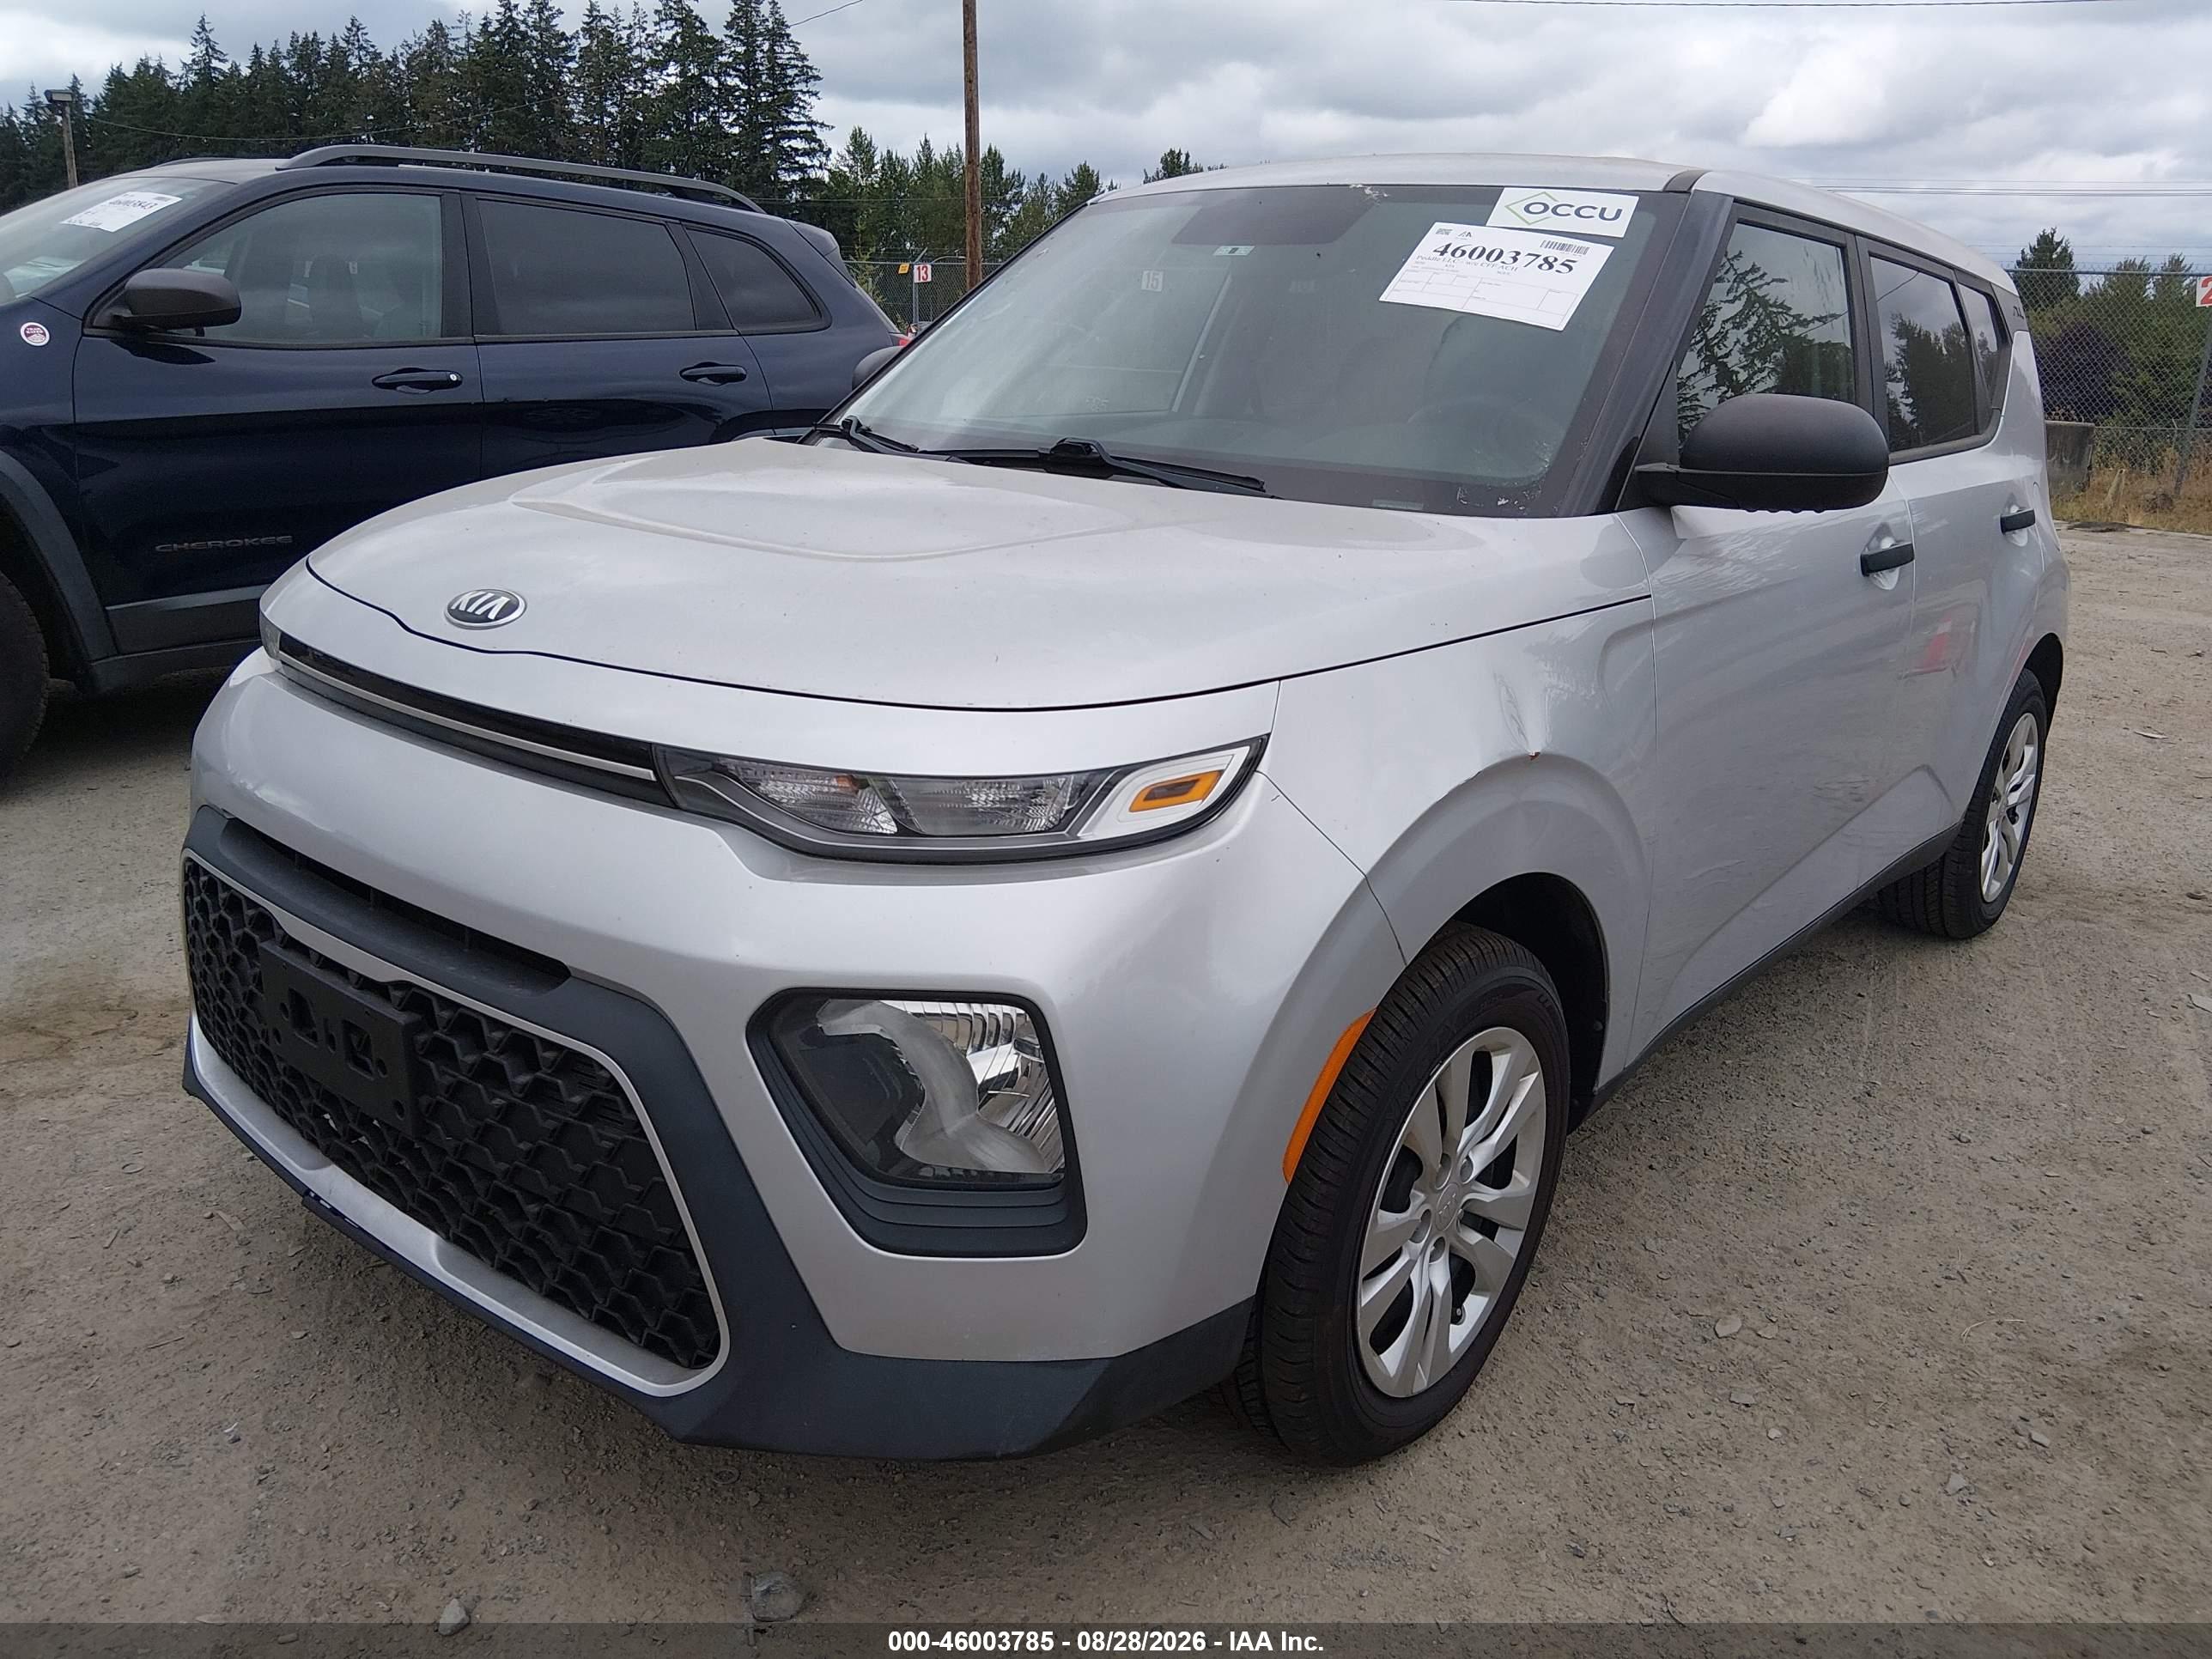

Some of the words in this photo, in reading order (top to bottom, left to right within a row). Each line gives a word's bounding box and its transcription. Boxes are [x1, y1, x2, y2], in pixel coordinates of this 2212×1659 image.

[1523, 201, 1624, 222] OCCU
[1432, 241, 1579, 275] 46003785
[916, 264, 929, 282] 13
[155, 535, 293, 552] CHEROKEE
[450, 591, 511, 620] KIA
